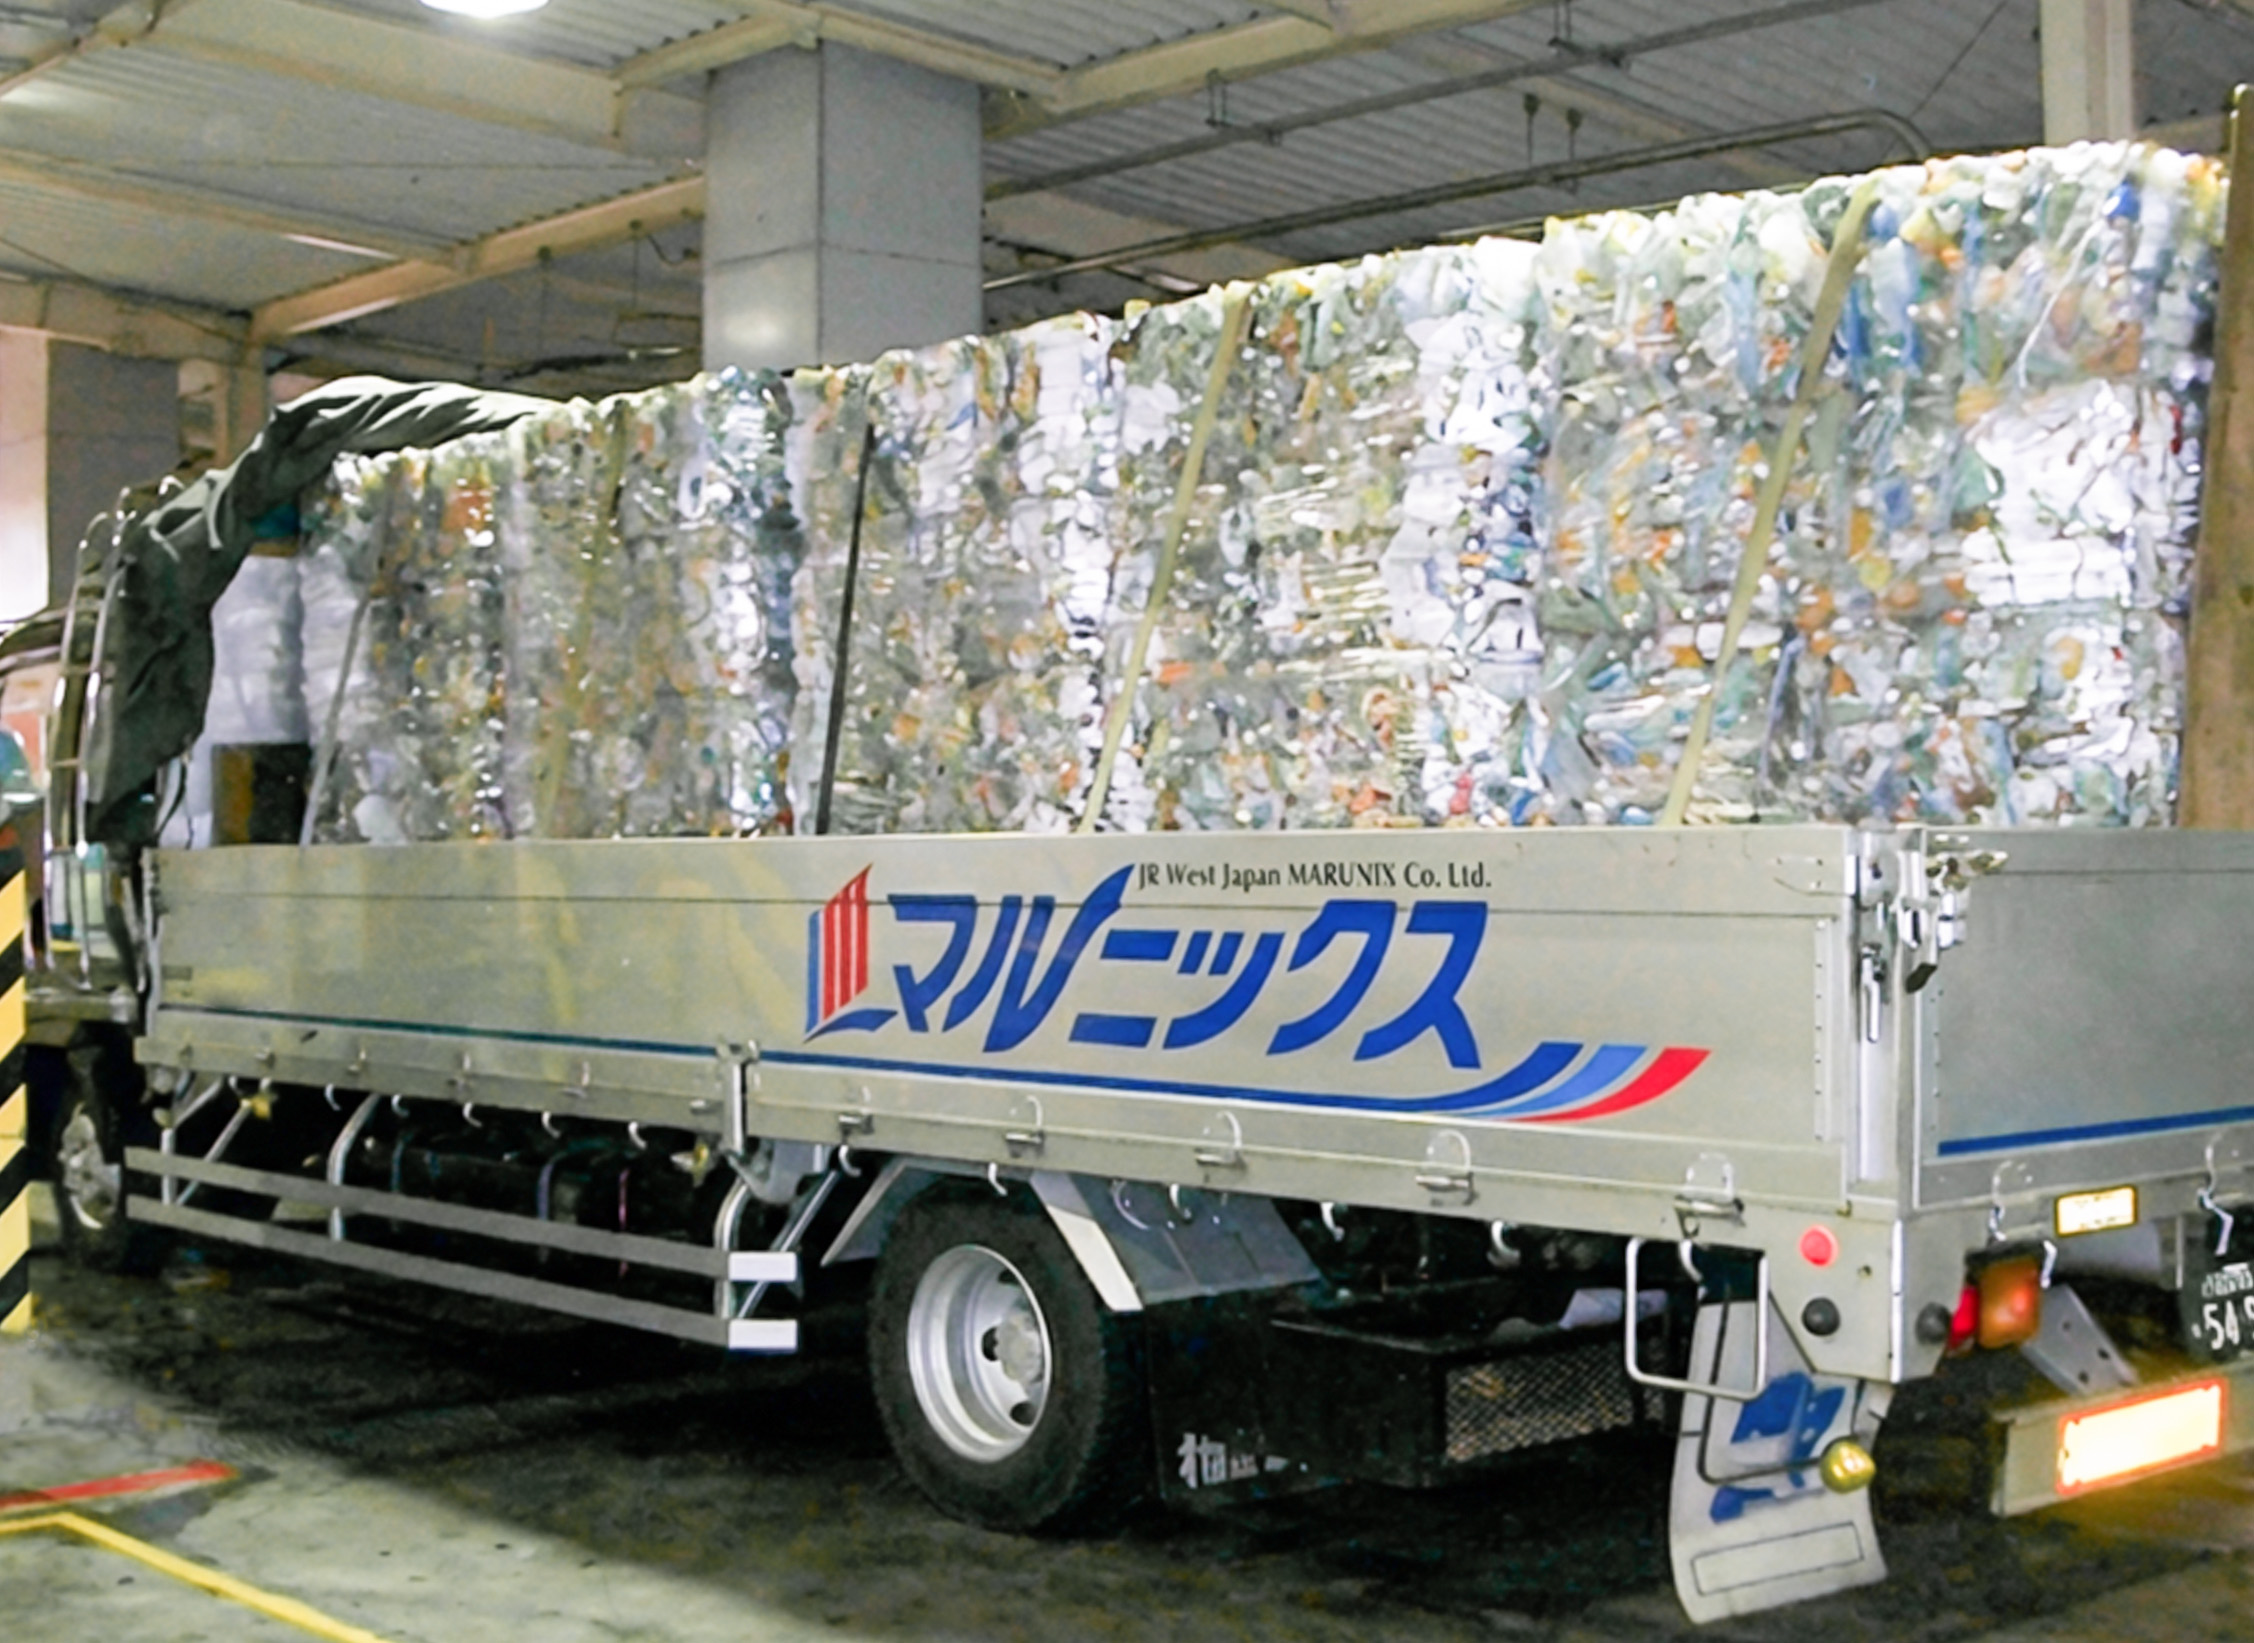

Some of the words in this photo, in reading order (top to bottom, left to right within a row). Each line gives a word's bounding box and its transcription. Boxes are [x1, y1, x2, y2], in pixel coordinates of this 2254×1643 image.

[1139, 863, 1160, 890] JR
[1166, 863, 1215, 886] West
[1221, 863, 1281, 893] Japan
[1288, 862, 1396, 887] MARUNIX
[1403, 861, 1441, 888] Co.
[1449, 861, 1491, 888] Ltd.
[888, 866, 1488, 1069] マルニックス
